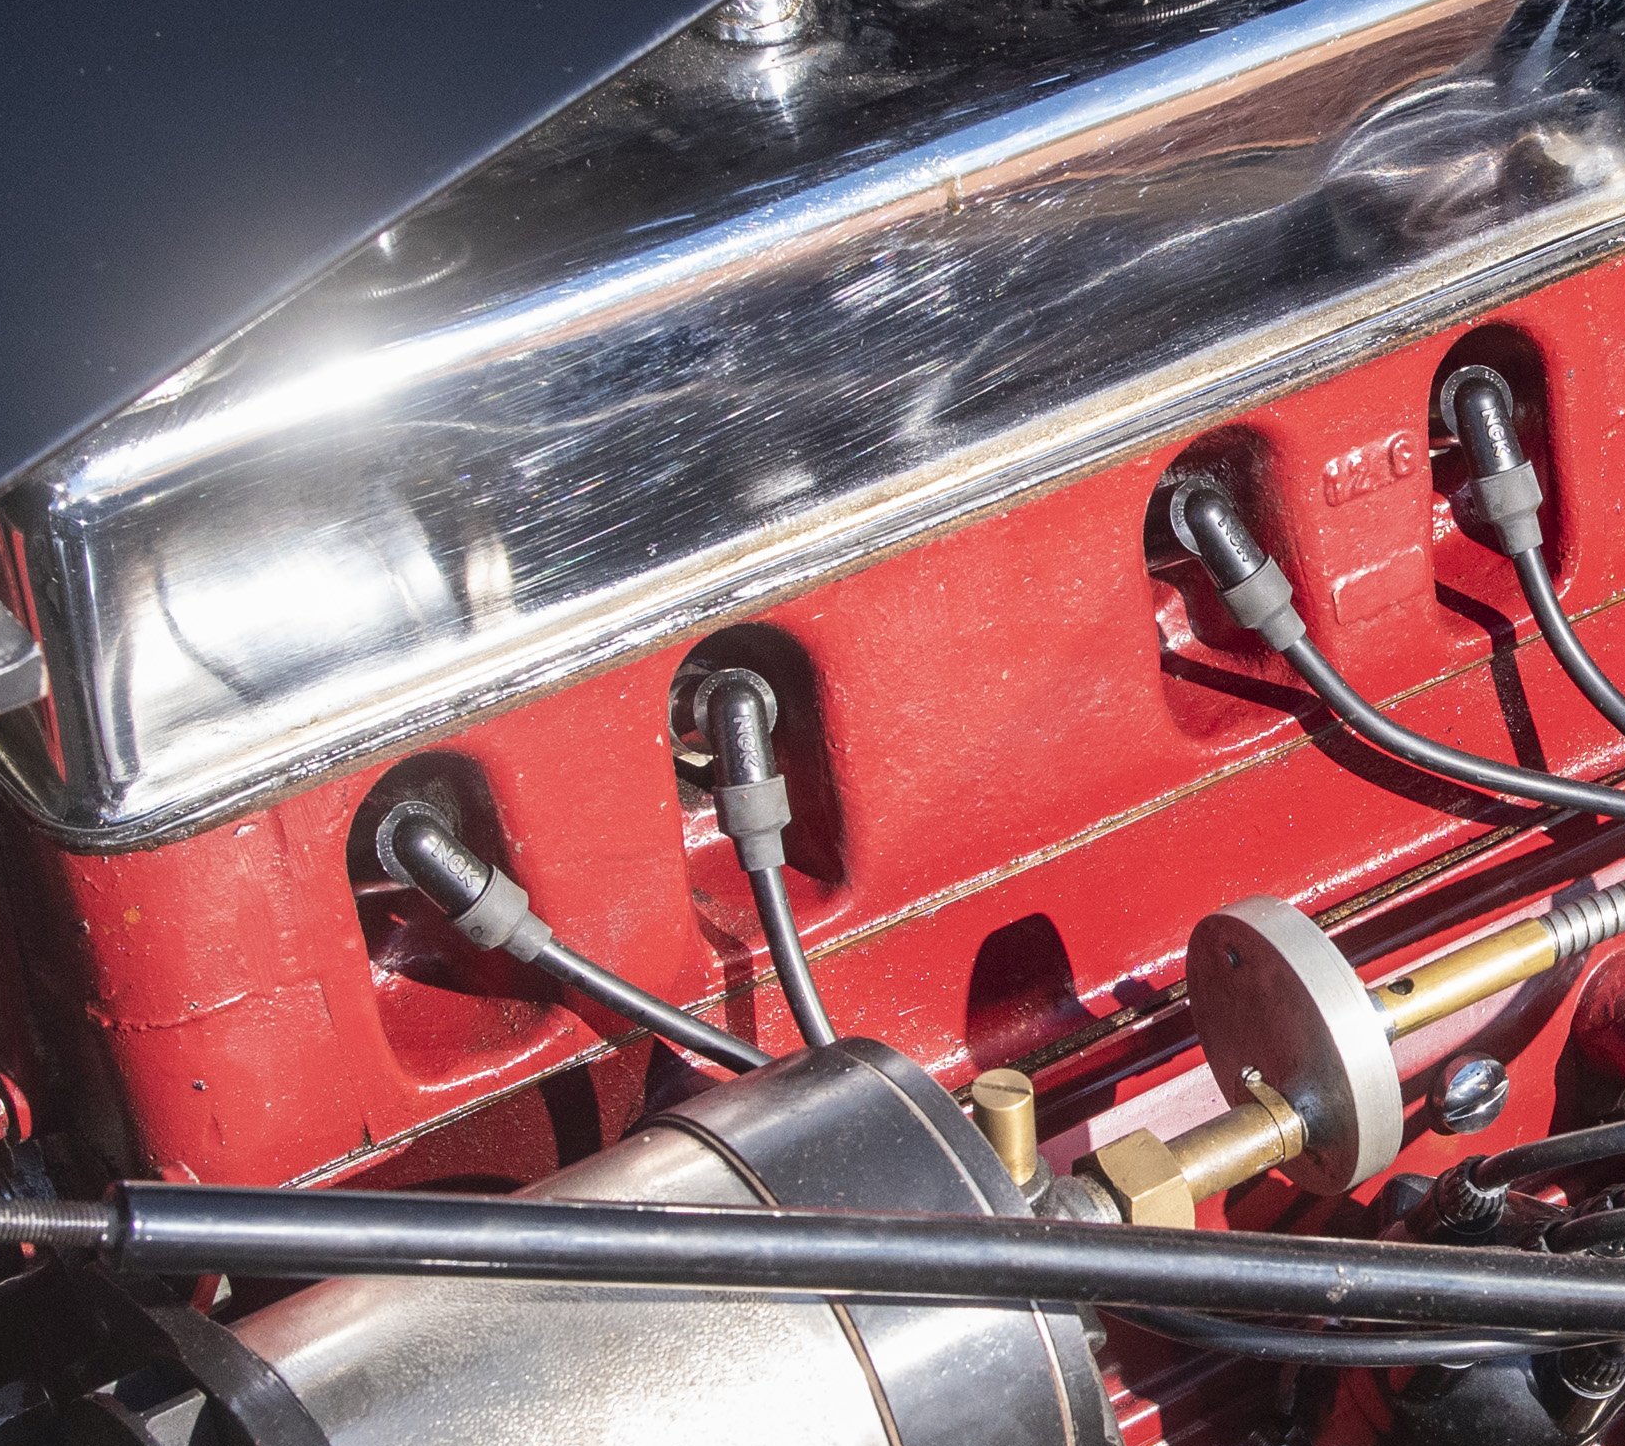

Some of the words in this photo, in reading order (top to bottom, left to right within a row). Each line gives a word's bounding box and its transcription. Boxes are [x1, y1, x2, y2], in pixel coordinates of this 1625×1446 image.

[1481, 408, 1511, 458] NGK
[1218, 516, 1250, 562] NGK
[733, 715, 760, 767] NGK
[431, 840, 480, 888] NGK
